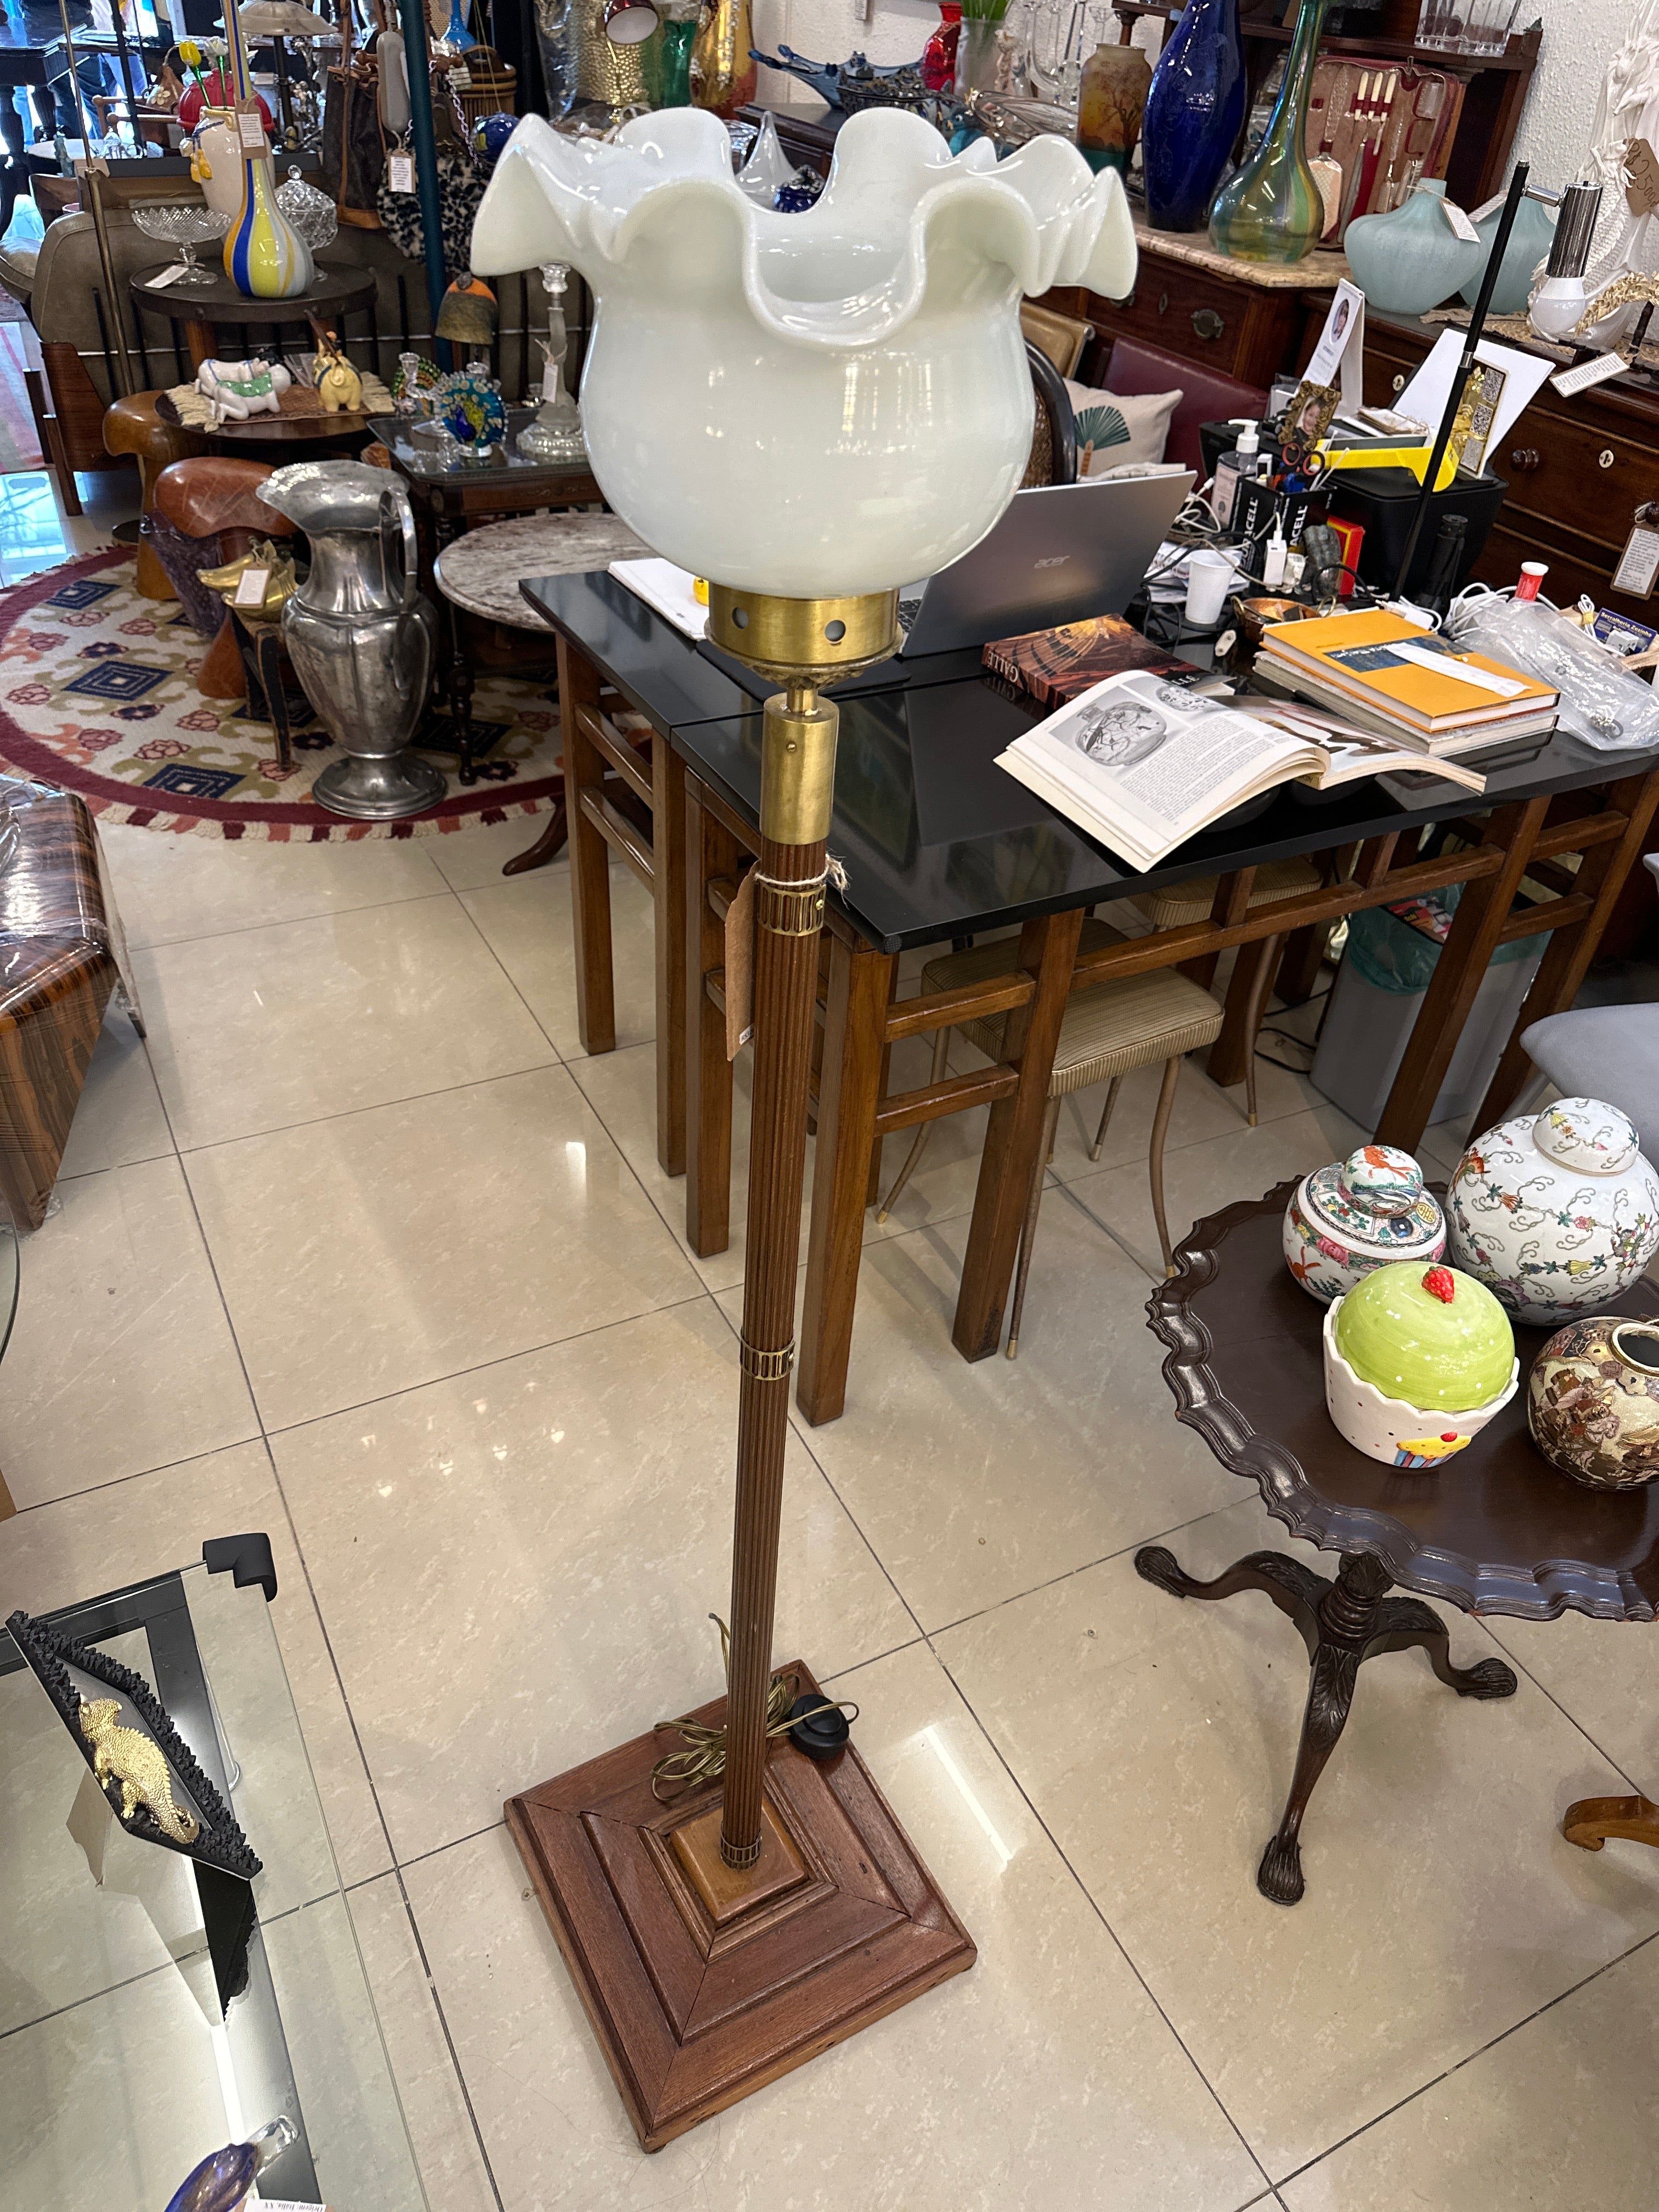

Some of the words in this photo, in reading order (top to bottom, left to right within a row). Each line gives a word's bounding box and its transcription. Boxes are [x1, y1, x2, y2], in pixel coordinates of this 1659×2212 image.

[1290, 505, 1308, 546] ACELL
[1034, 556, 1070, 569] acer
[1630, 625, 1652, 637] Zezinho
[1171, 674, 1200, 685] LLÉ
